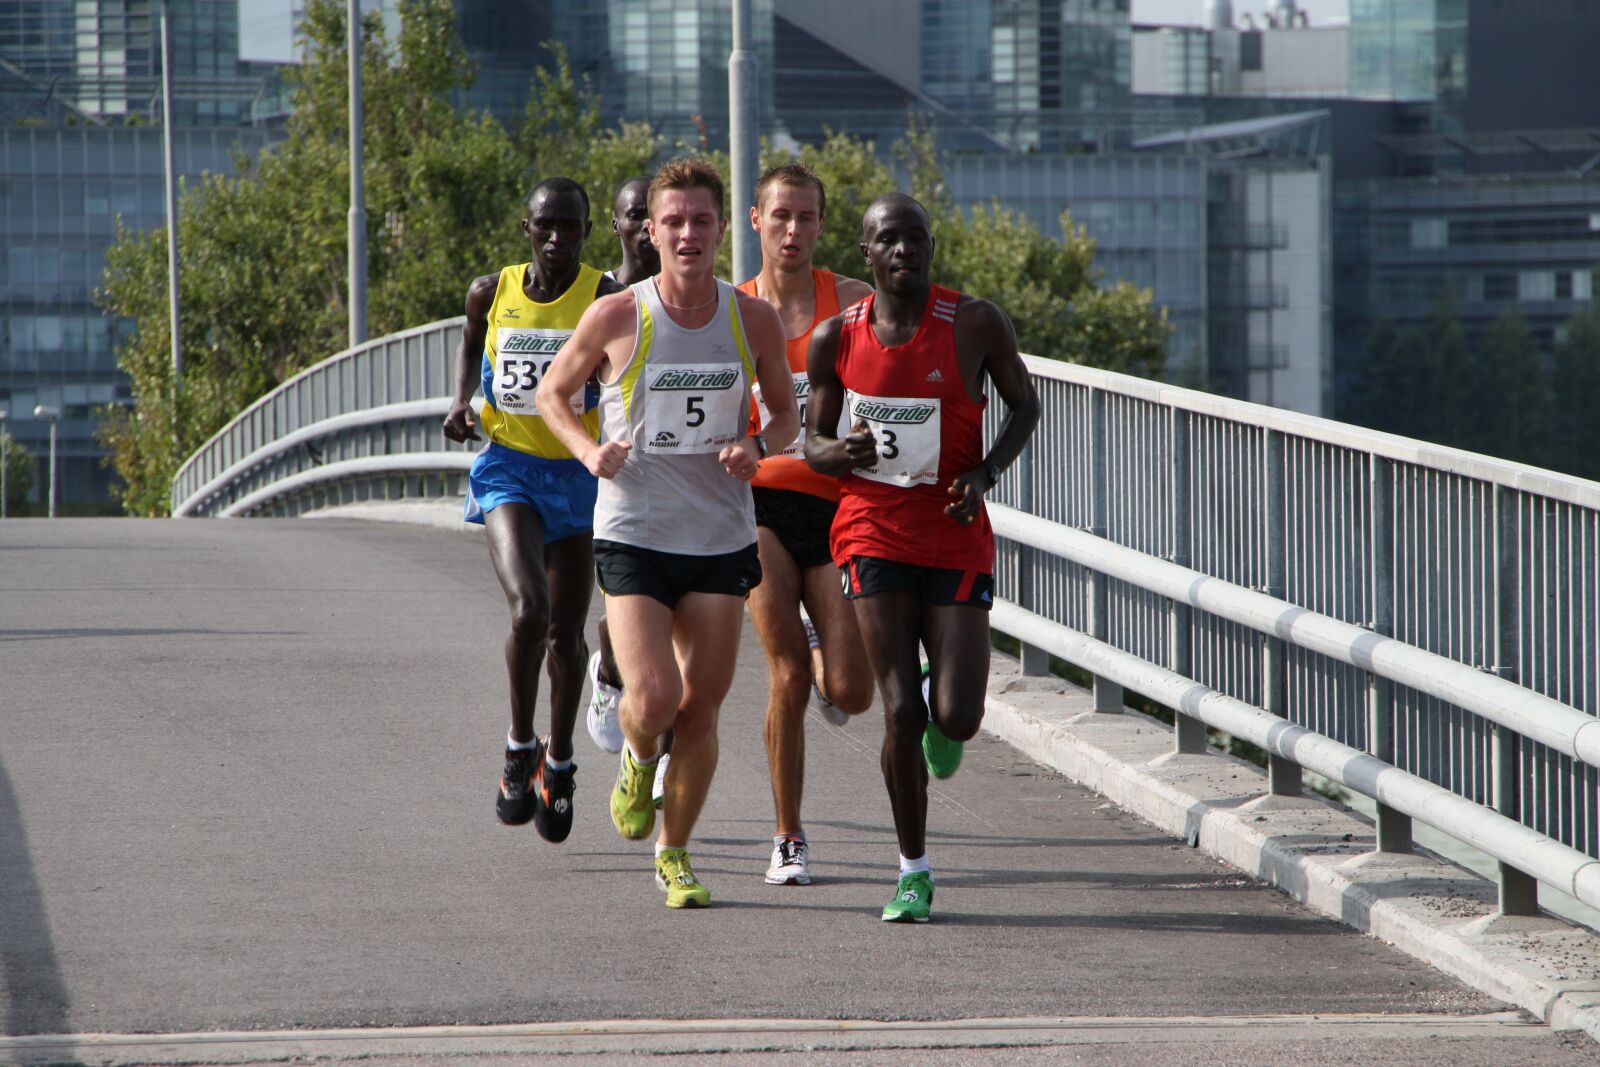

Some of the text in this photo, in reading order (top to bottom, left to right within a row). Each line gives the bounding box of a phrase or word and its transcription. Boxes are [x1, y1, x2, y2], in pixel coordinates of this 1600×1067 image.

[503, 334, 571, 351] Gatorad
[653, 370, 736, 388] Gatorade
[686, 396, 706, 428] 5
[853, 401, 935, 422] Gatorade
[648, 440, 680, 448] KARHU
[881, 429, 900, 460] 3
